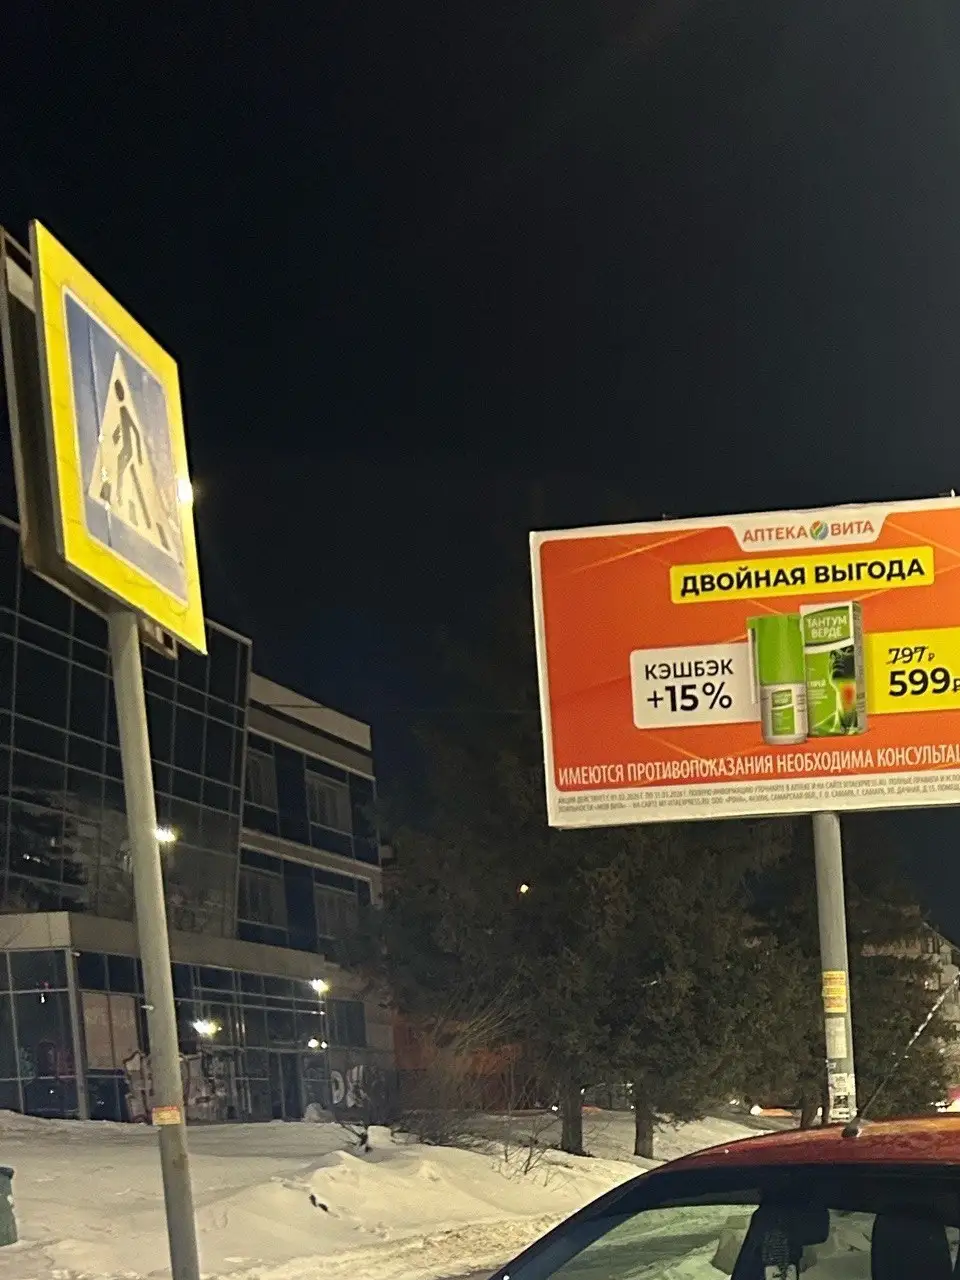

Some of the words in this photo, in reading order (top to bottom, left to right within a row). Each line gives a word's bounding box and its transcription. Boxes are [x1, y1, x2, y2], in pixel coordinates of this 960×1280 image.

[742, 525, 809, 543] АПТЕКА
[830, 520, 875, 536] ВИТА
[680, 565, 806, 597] ДВОЙНАЯ
[814, 558, 926, 583] ВЫГОДА
[807, 615, 848, 628] ТАНТУМ
[810, 627, 842, 639] ВЕРДЕ
[645, 658, 734, 680] КЭШБЭК
[647, 681, 732, 712] +15%
[558, 764, 623, 785] ИМЕЮТСЯ
[627, 754, 774, 782] ПРОТИВОПОКАЗАНИЯ
[777, 749, 874, 774] НЕОБХОДИМА
